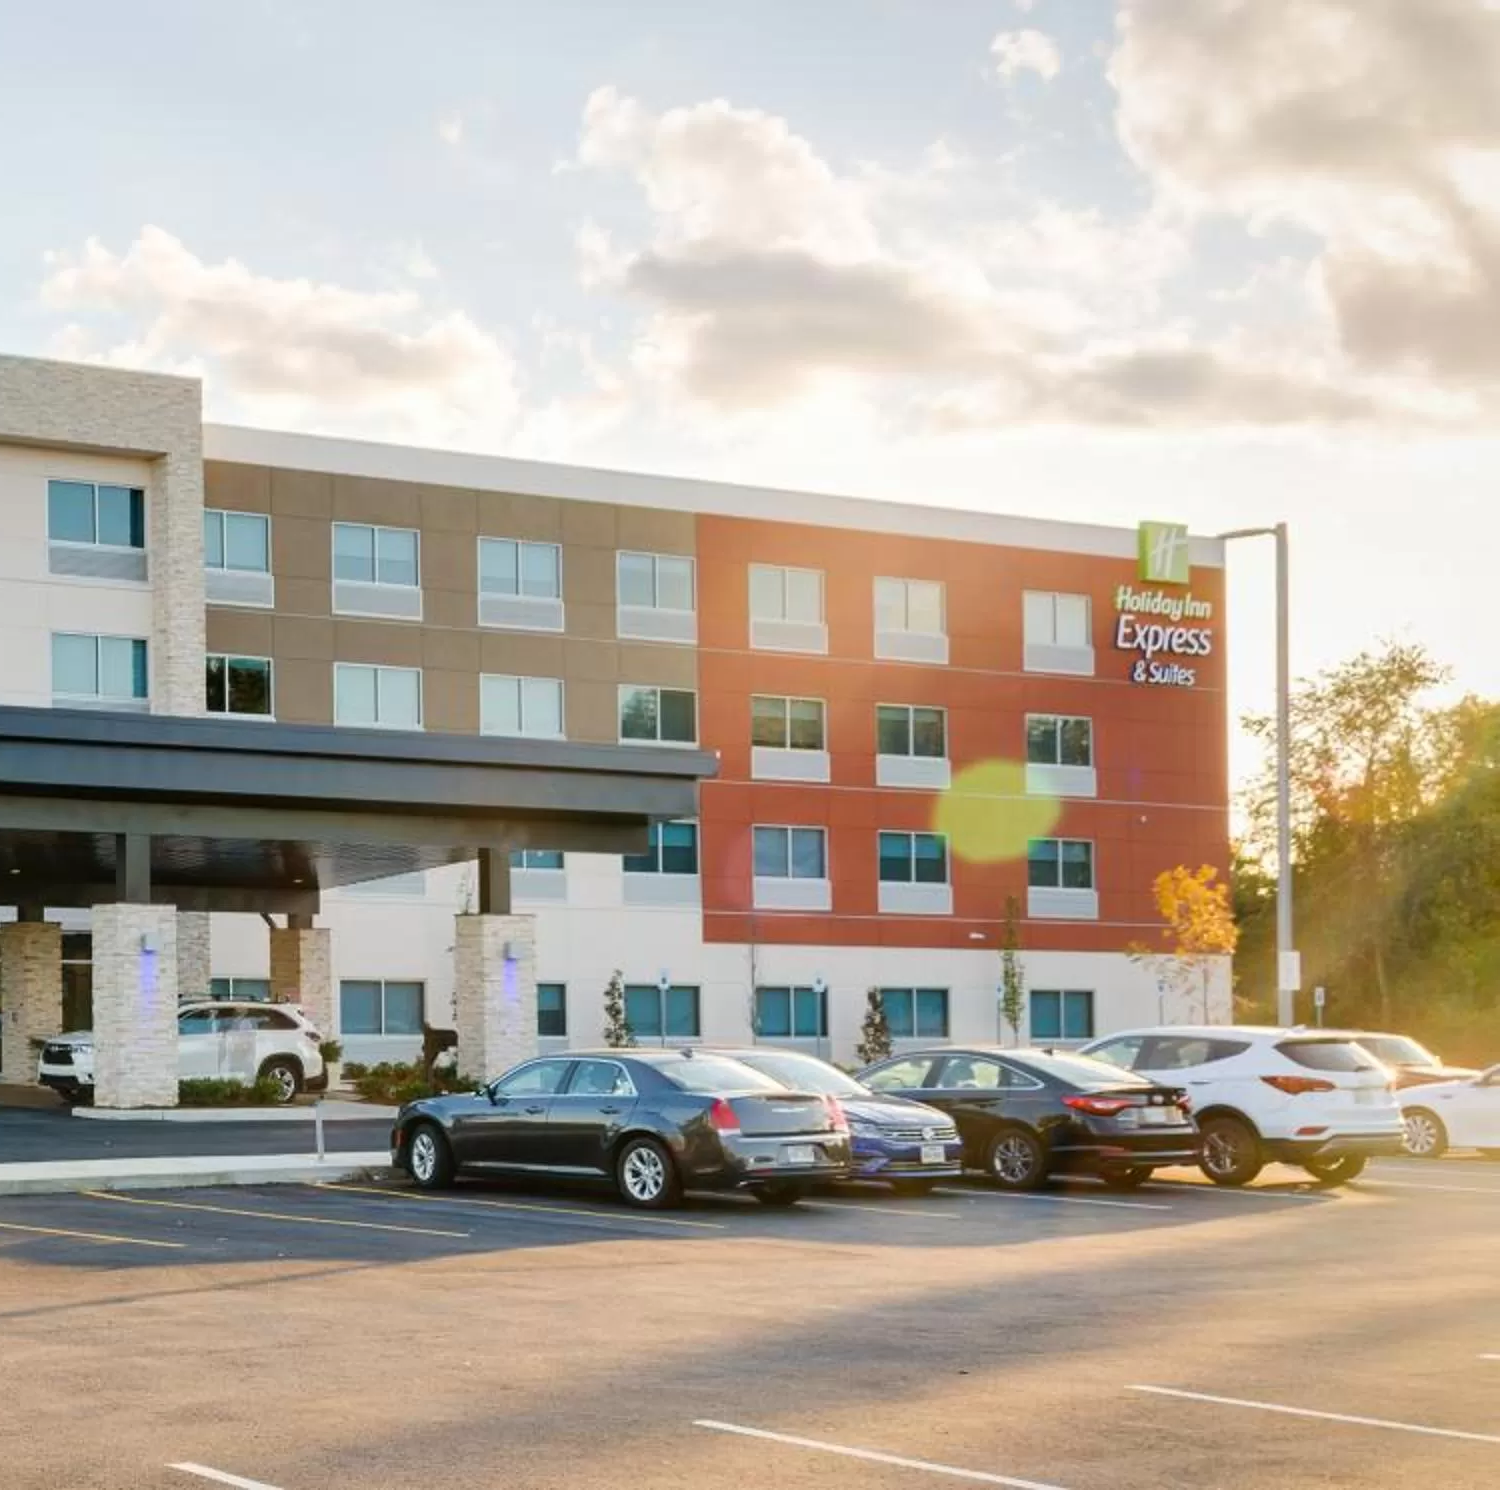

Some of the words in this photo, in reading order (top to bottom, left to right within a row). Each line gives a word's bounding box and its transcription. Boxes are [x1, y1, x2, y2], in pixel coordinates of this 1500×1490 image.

[1116, 585, 1183, 621] Holiday
[1184, 592, 1212, 619] Inn
[1117, 613, 1213, 660] Express
[1132, 659, 1147, 682] &
[1148, 661, 1196, 687] Suites
